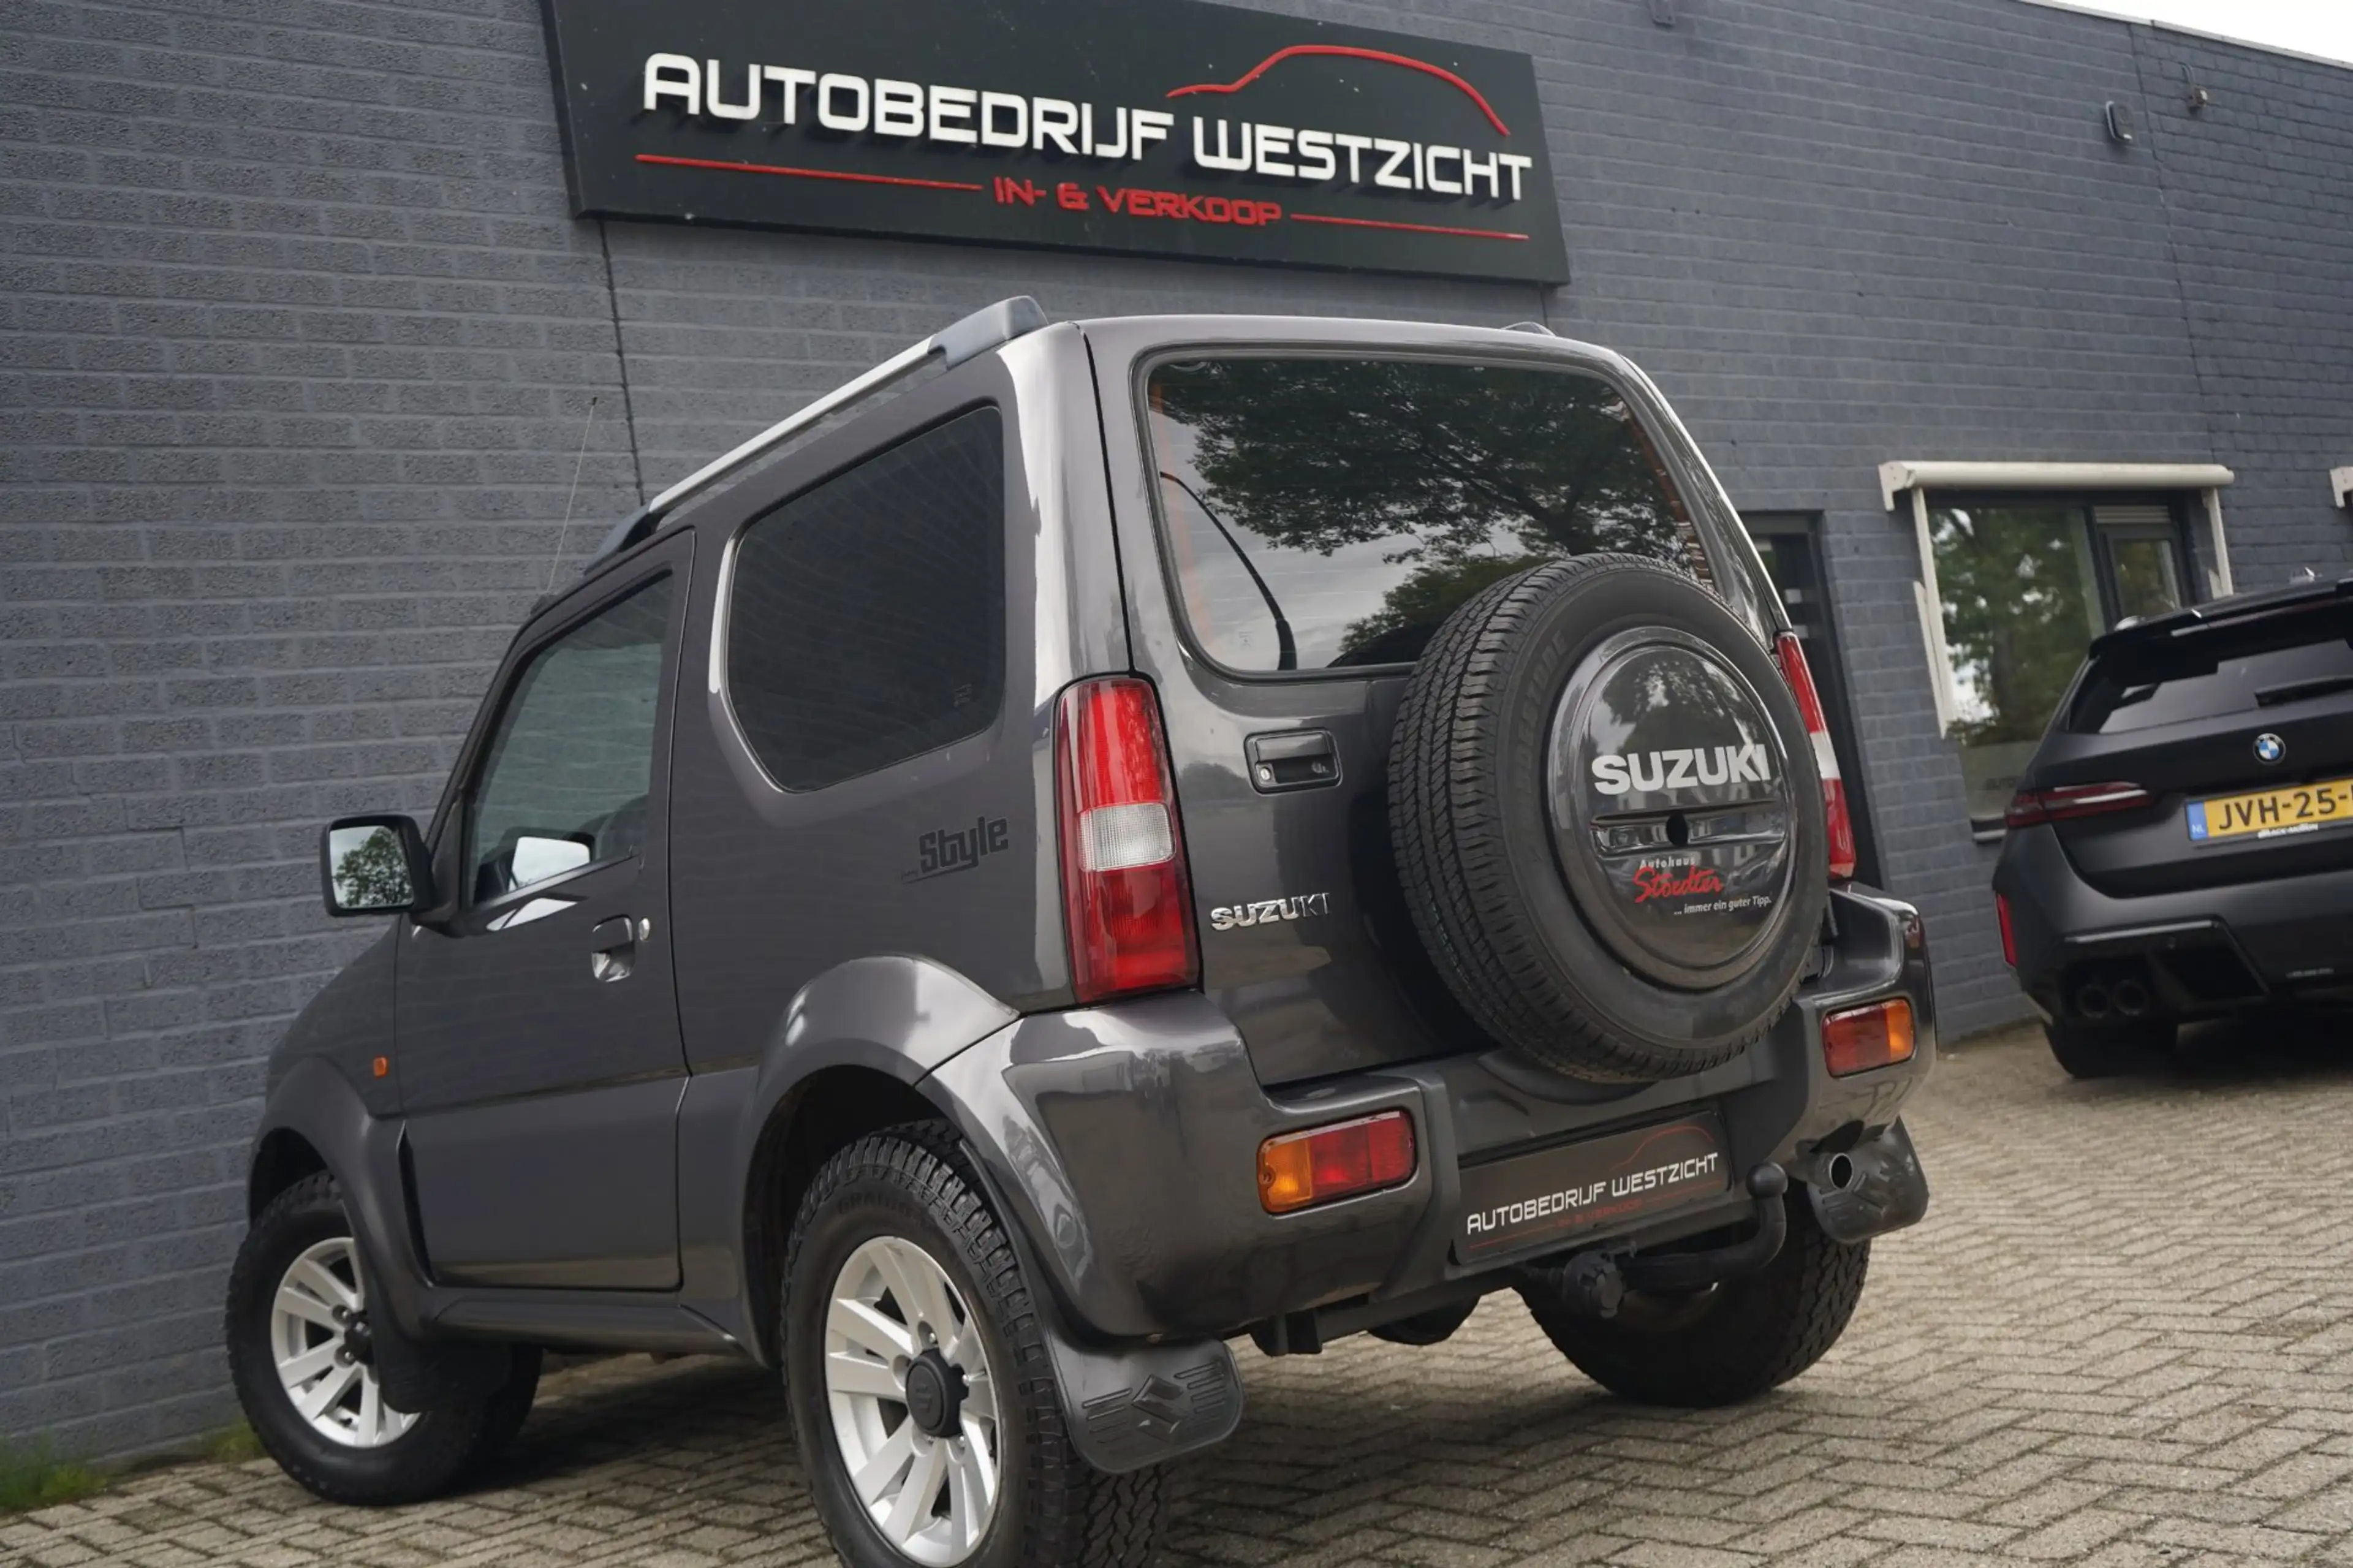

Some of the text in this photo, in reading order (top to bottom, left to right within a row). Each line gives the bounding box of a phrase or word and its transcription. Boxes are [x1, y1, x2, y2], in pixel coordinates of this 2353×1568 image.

[643, 52, 1533, 201] AUTOBEDRIJF WESTZICHT
[993, 176, 1283, 225] IN- & VERKOOP
[1591, 743, 1771, 795] SUZUKI
[2218, 784, 2353, 830] JVH-25-
[917, 816, 1010, 875] Style
[1639, 855, 1696, 869] Autohaus
[1211, 892, 1329, 931] SUZUKI
[1684, 903, 1711, 914] immer
[1713, 900, 1727, 911] ein
[1729, 898, 1751, 912] guter
[1752, 895, 1771, 908] Tipp.
[1467, 1153, 1718, 1235] AUTOBEDRIJF WESTZICHT
